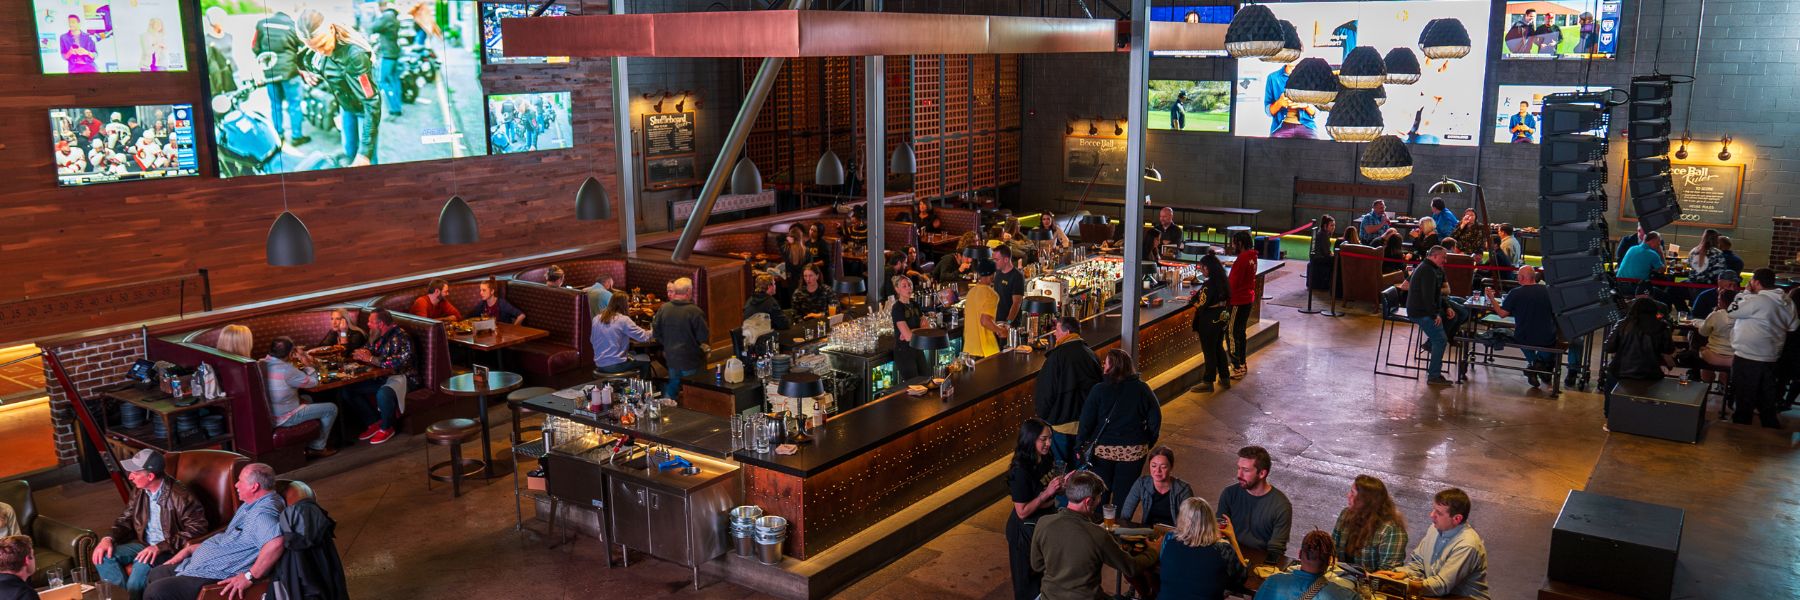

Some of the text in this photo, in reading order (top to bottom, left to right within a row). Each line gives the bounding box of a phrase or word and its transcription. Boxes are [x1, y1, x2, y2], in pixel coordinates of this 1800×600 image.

[1080, 138, 1114, 148] Bocce Ball
[1687, 166, 1708, 176] Ball
